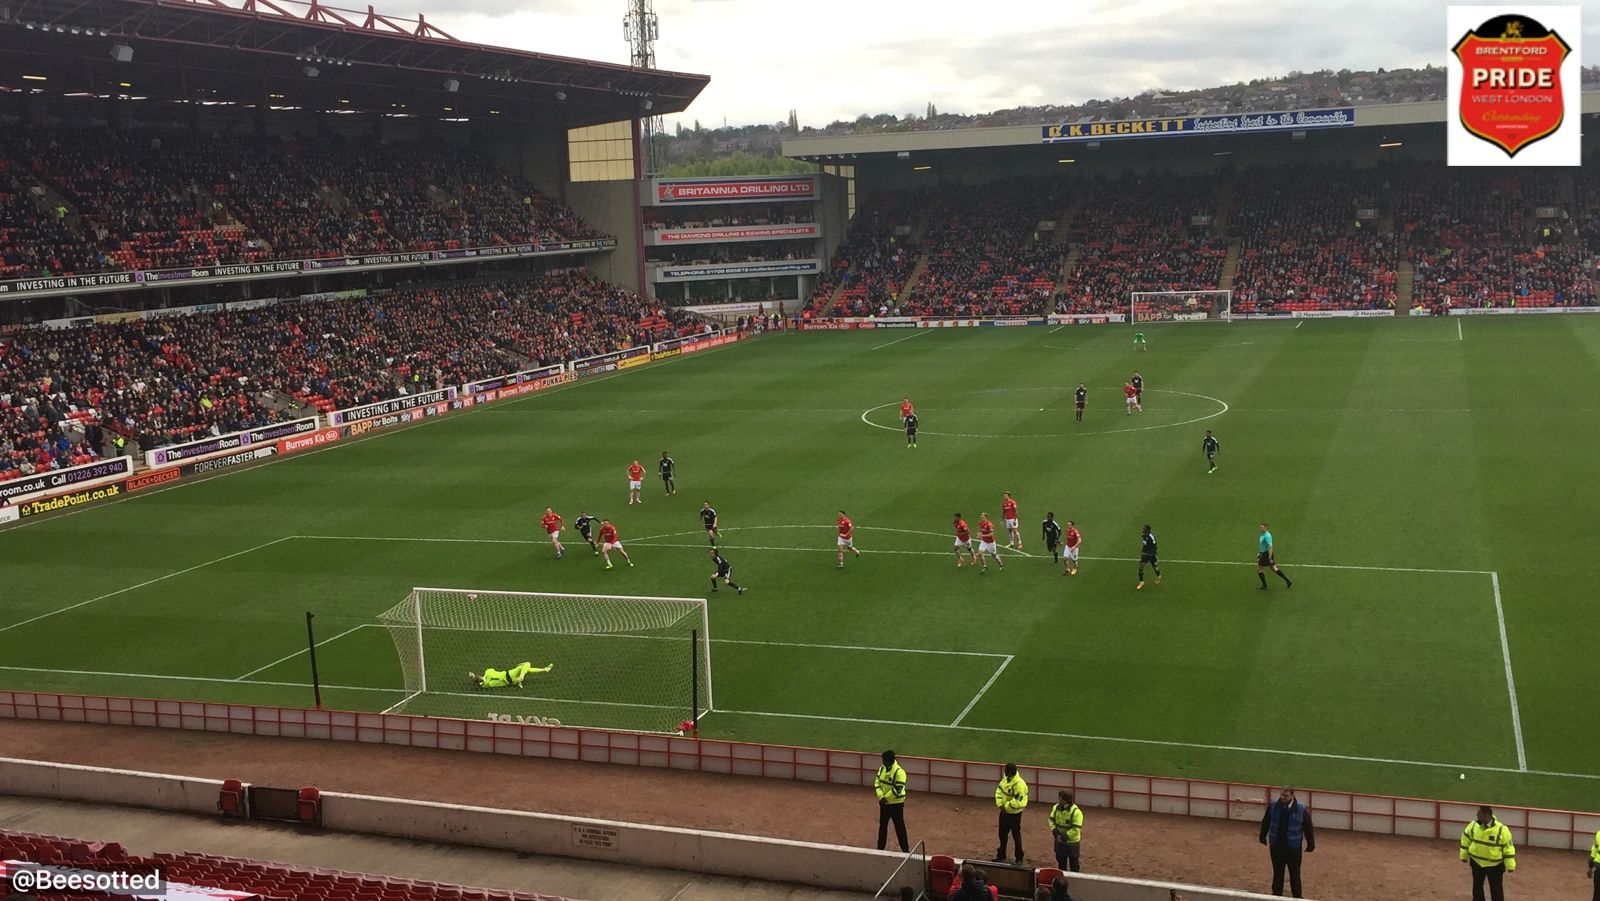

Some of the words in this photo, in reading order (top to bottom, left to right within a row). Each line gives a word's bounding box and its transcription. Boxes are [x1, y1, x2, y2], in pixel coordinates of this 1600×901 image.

[1194, 118, 1238, 132] Supporting
[1240, 115, 1264, 129] Sport
[1266, 115, 1278, 125] in
[1280, 113, 1294, 125] the
[1296, 111, 1348, 125] Community
[678, 186, 738, 196] BRITANNIA
[740, 184, 789, 194] DRILLING
[790, 184, 810, 192] LTD
[479, 246, 502, 255] INVESTING
[363, 256, 392, 265] INVESTING
[400, 254, 410, 262] THE
[411, 253, 430, 262] FUTURE
[214, 265, 251, 276] INVESTING
[252, 264, 260, 273] IN
[262, 264, 275, 272] THE
[276, 262, 300, 271] FUTURE
[16, 278, 65, 291] INVESTING
[67, 278, 77, 287] IN
[80, 276, 97, 286] THE
[99, 274, 130, 285] FUTURE
[1137, 313, 1162, 321] BAPP
[518, 384, 533, 394] Toyota
[453, 399, 463, 409] sky
[463, 396, 474, 407] BET
[476, 393, 486, 403] sky
[486, 391, 496, 401] BET
[347, 404, 389, 421] INVESTING
[391, 402, 400, 411] IN
[402, 398, 416, 408] THE
[418, 392, 444, 406] FUTURE
[426, 406, 436, 416] sky
[437, 404, 447, 414] BET
[401, 412, 411, 422] sky
[412, 410, 423, 420] BET
[350, 421, 373, 436] BAPP
[373, 419, 381, 427] for
[382, 415, 398, 425] Bolts
[285, 437, 314, 451] Burrows
[314, 433, 325, 443] Kia
[51, 474, 67, 487] Call
[67, 470, 91, 482] 01226
[93, 465, 107, 477] 392
[108, 462, 123, 473] 940
[128, 470, 179, 491] BLACK+DECKER
[32, 485, 119, 514] TradePoint.co.uk
